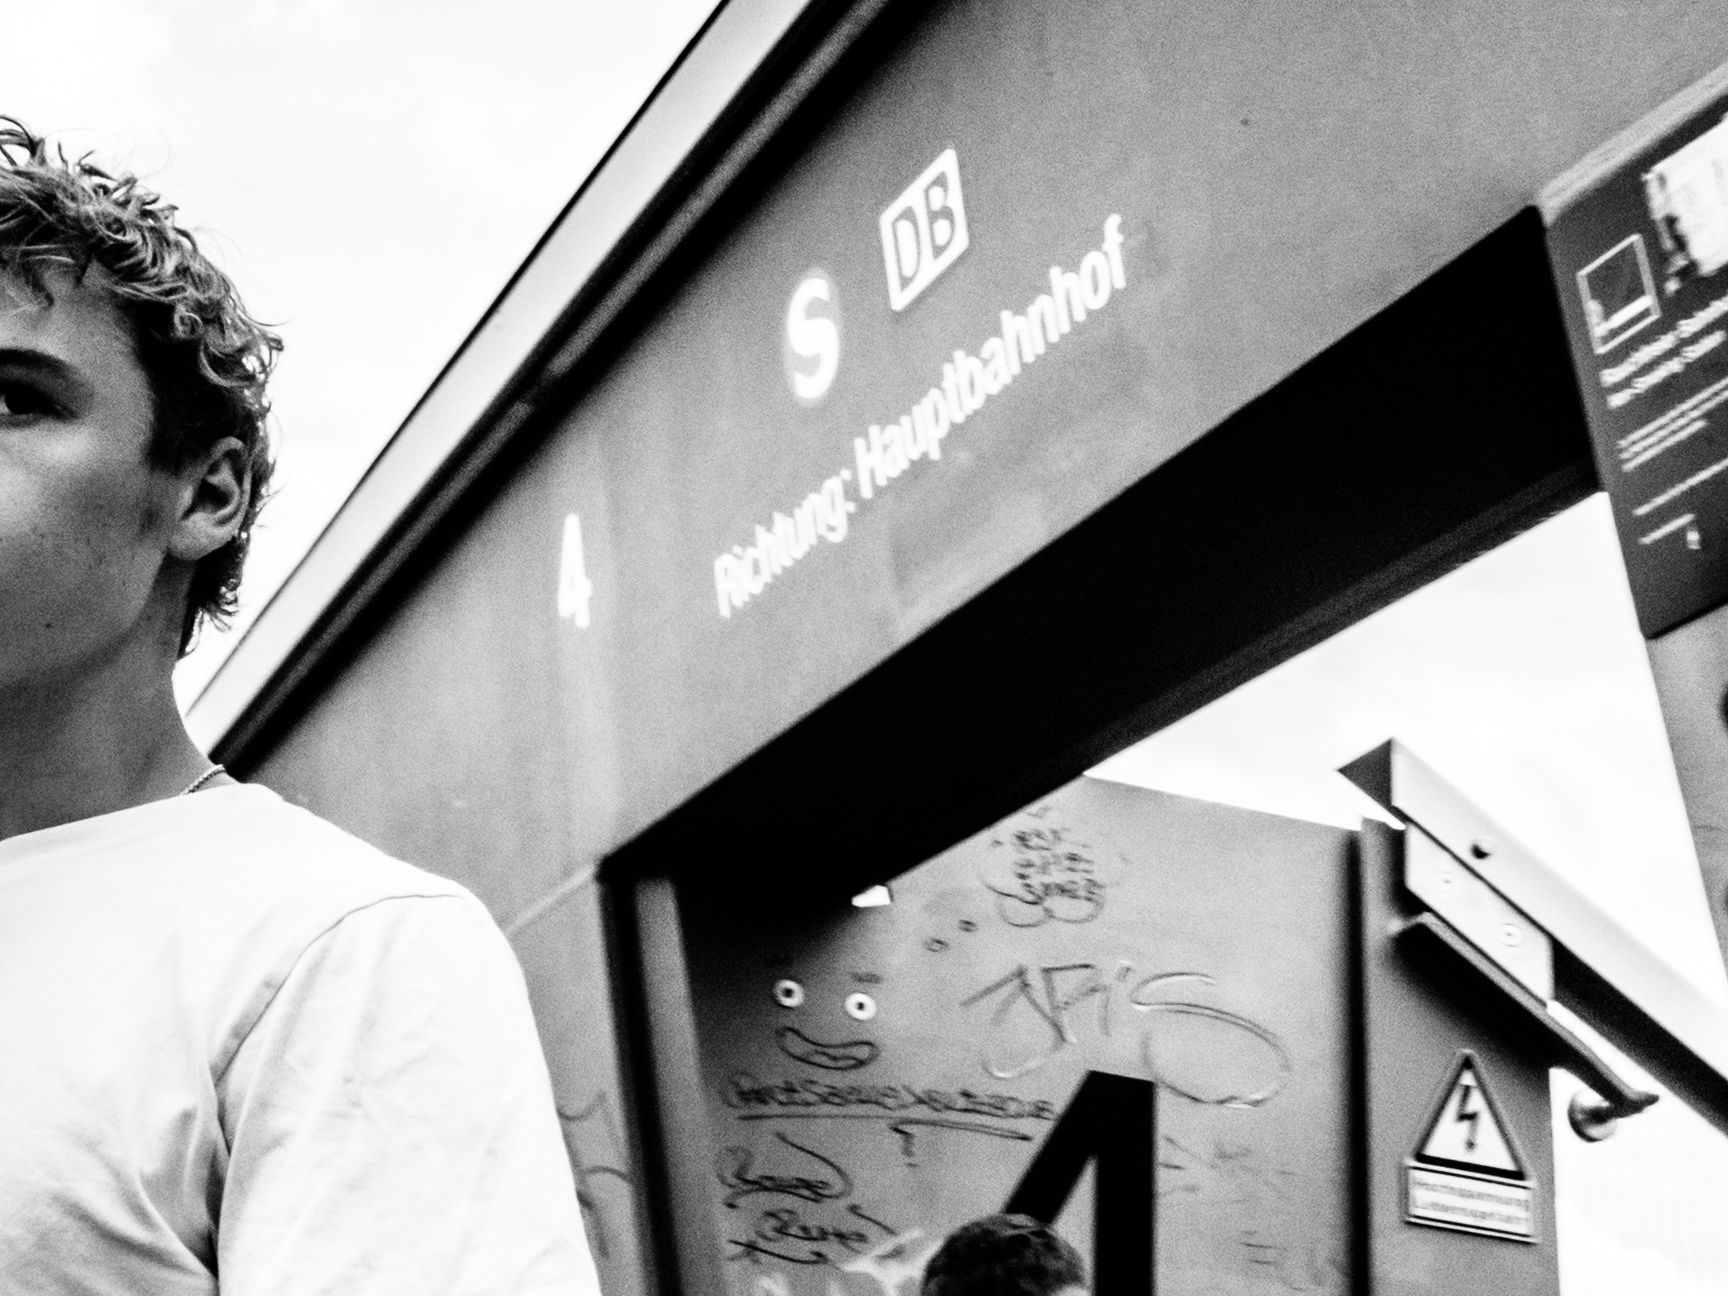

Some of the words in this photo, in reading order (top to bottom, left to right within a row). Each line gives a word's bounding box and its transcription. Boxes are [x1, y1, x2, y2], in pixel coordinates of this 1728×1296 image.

[879, 148, 969, 311] DB
[785, 276, 840, 399] S
[853, 212, 1127, 500] Hauptbahnhof
[557, 512, 592, 629] 4
